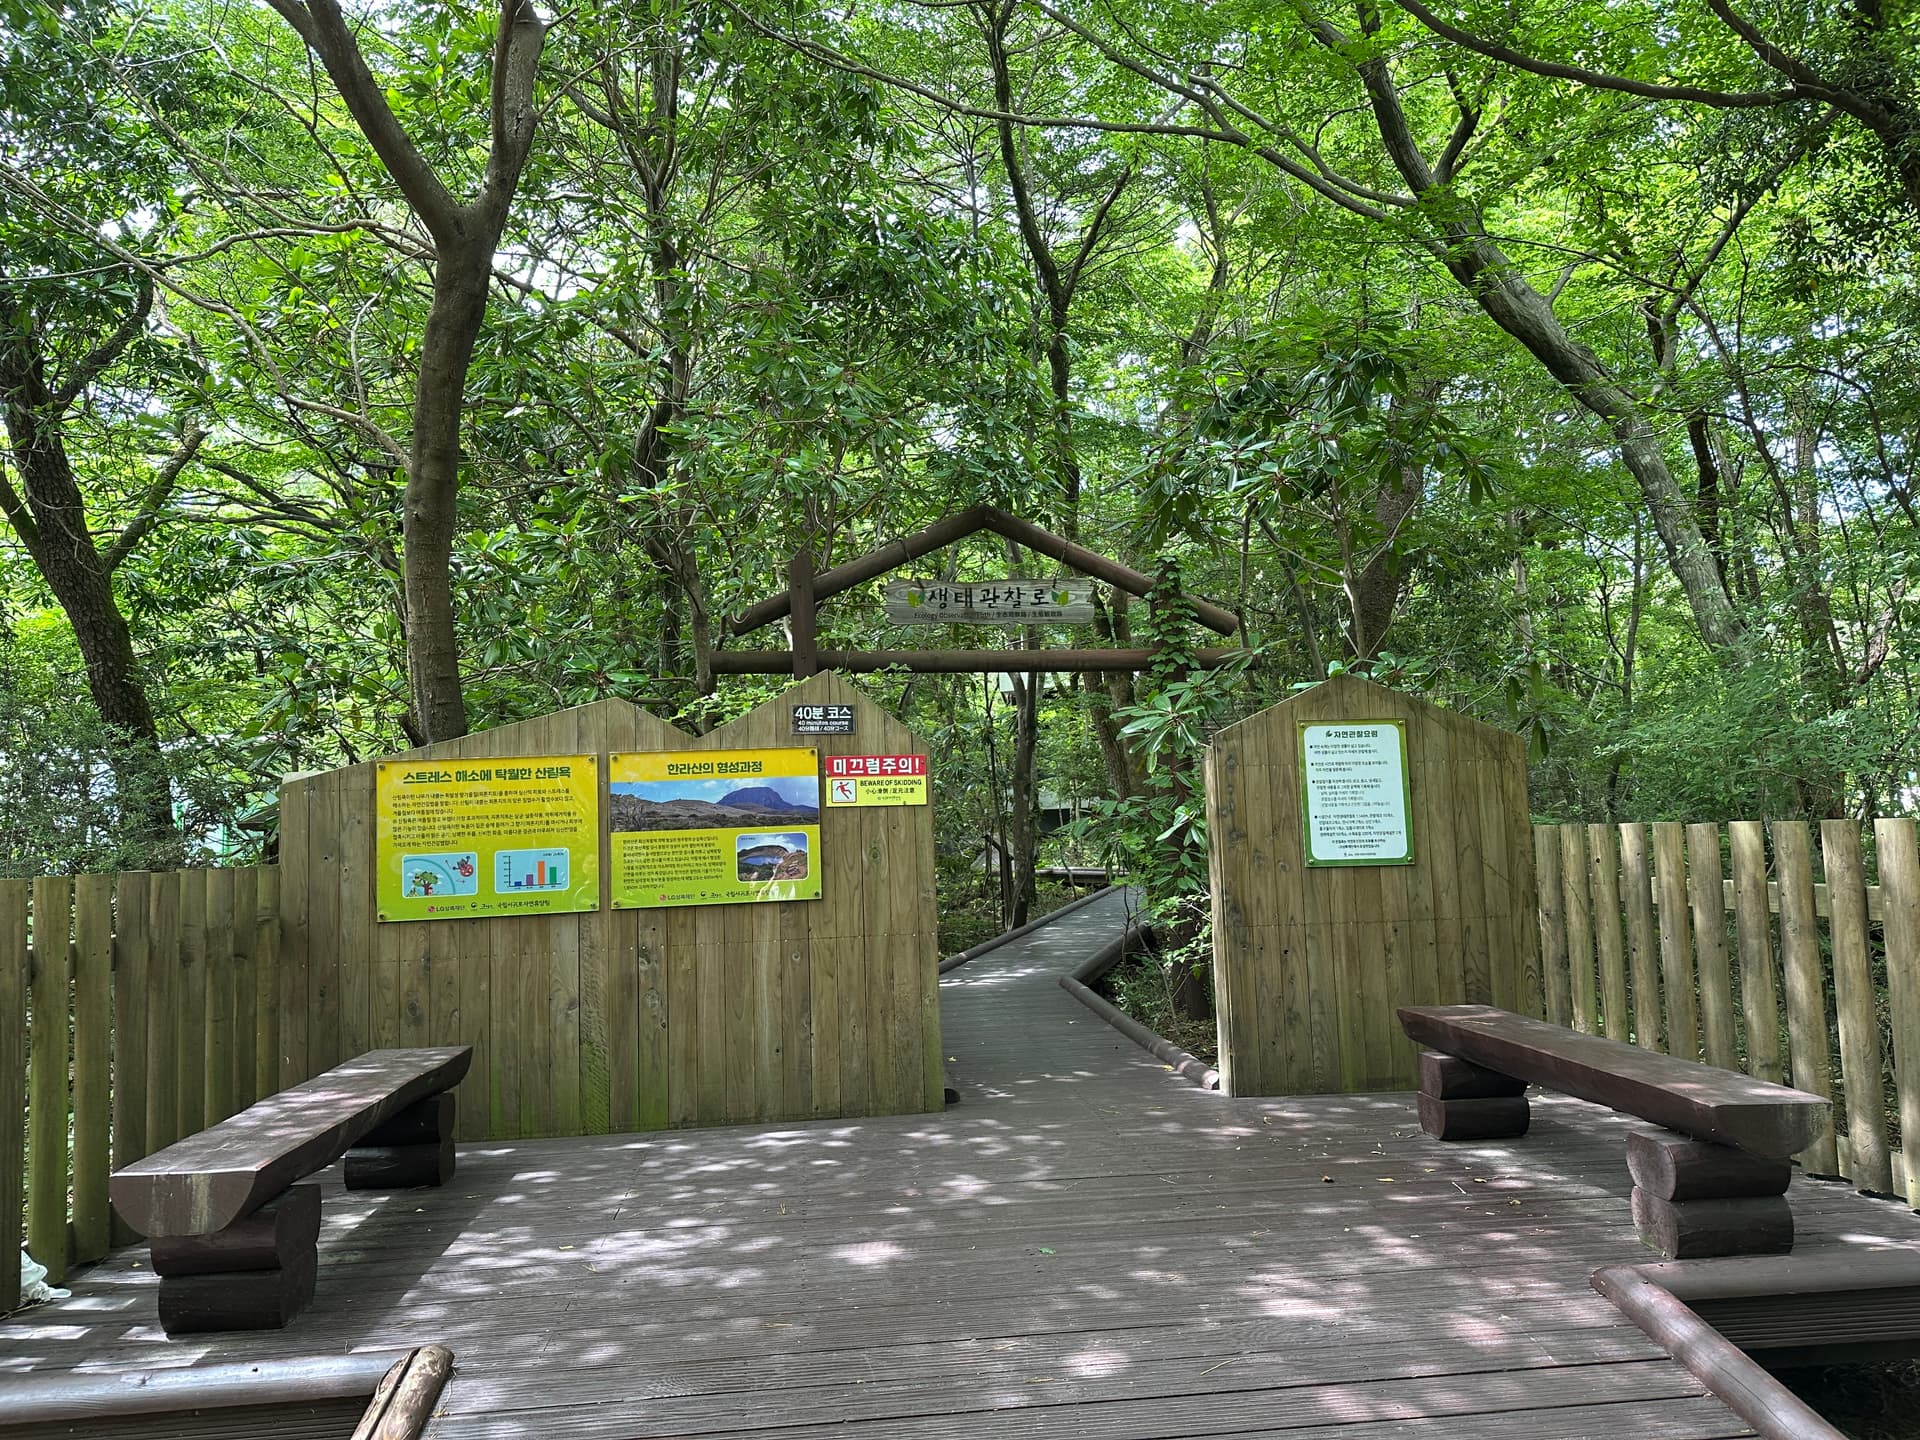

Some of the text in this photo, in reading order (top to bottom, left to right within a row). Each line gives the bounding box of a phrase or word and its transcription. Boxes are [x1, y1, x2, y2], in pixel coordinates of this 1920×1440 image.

[928, 587, 1050, 609] 생태관찰로
[794, 706, 852, 720] 40분 코스
[403, 765, 571, 784] 스트레스 해소에 탁월한 산림욕
[667, 760, 763, 776] 한라산의 형성과정
[833, 757, 920, 775] 미끄럼주의!
[860, 779, 884, 787] BEWARE
[894, 778, 922, 786] SKIDDING
